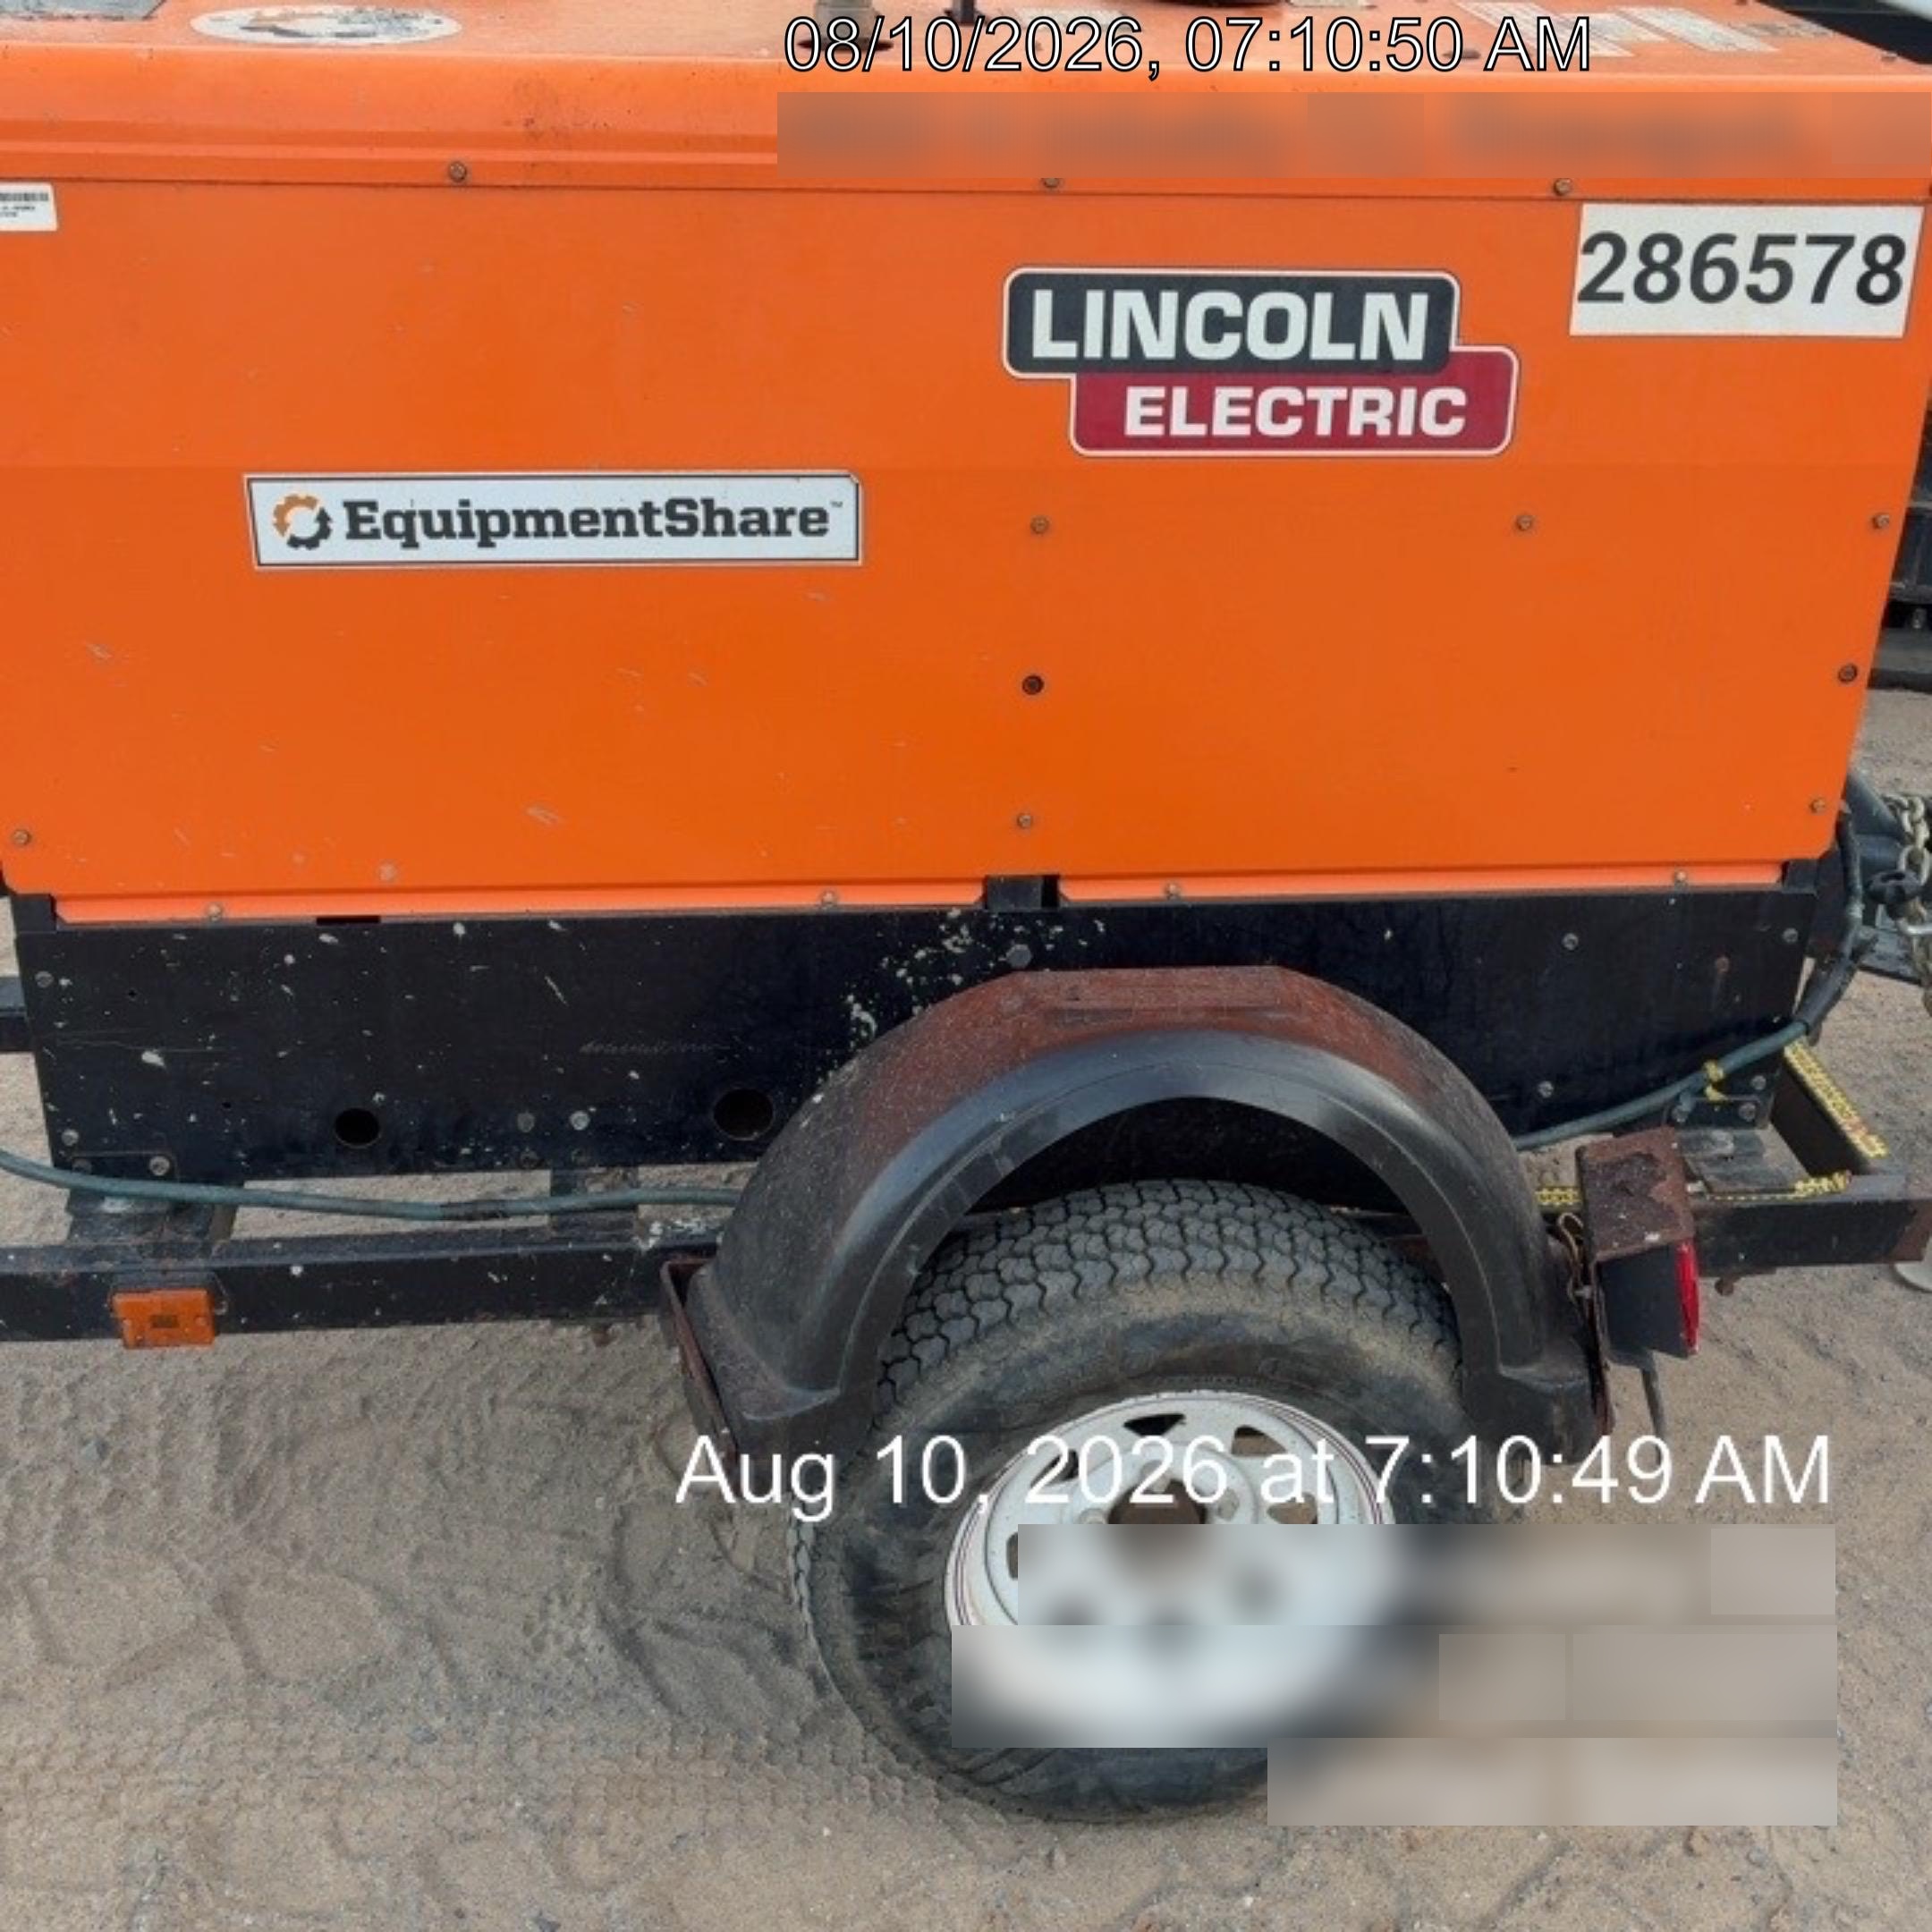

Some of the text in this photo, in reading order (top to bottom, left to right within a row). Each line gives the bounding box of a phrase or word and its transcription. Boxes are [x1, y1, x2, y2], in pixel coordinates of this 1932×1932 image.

[1578, 232, 1906, 305] 286578
[1032, 290, 1428, 360] LINCOLN
[1124, 386, 1467, 436] ELECTRIC
